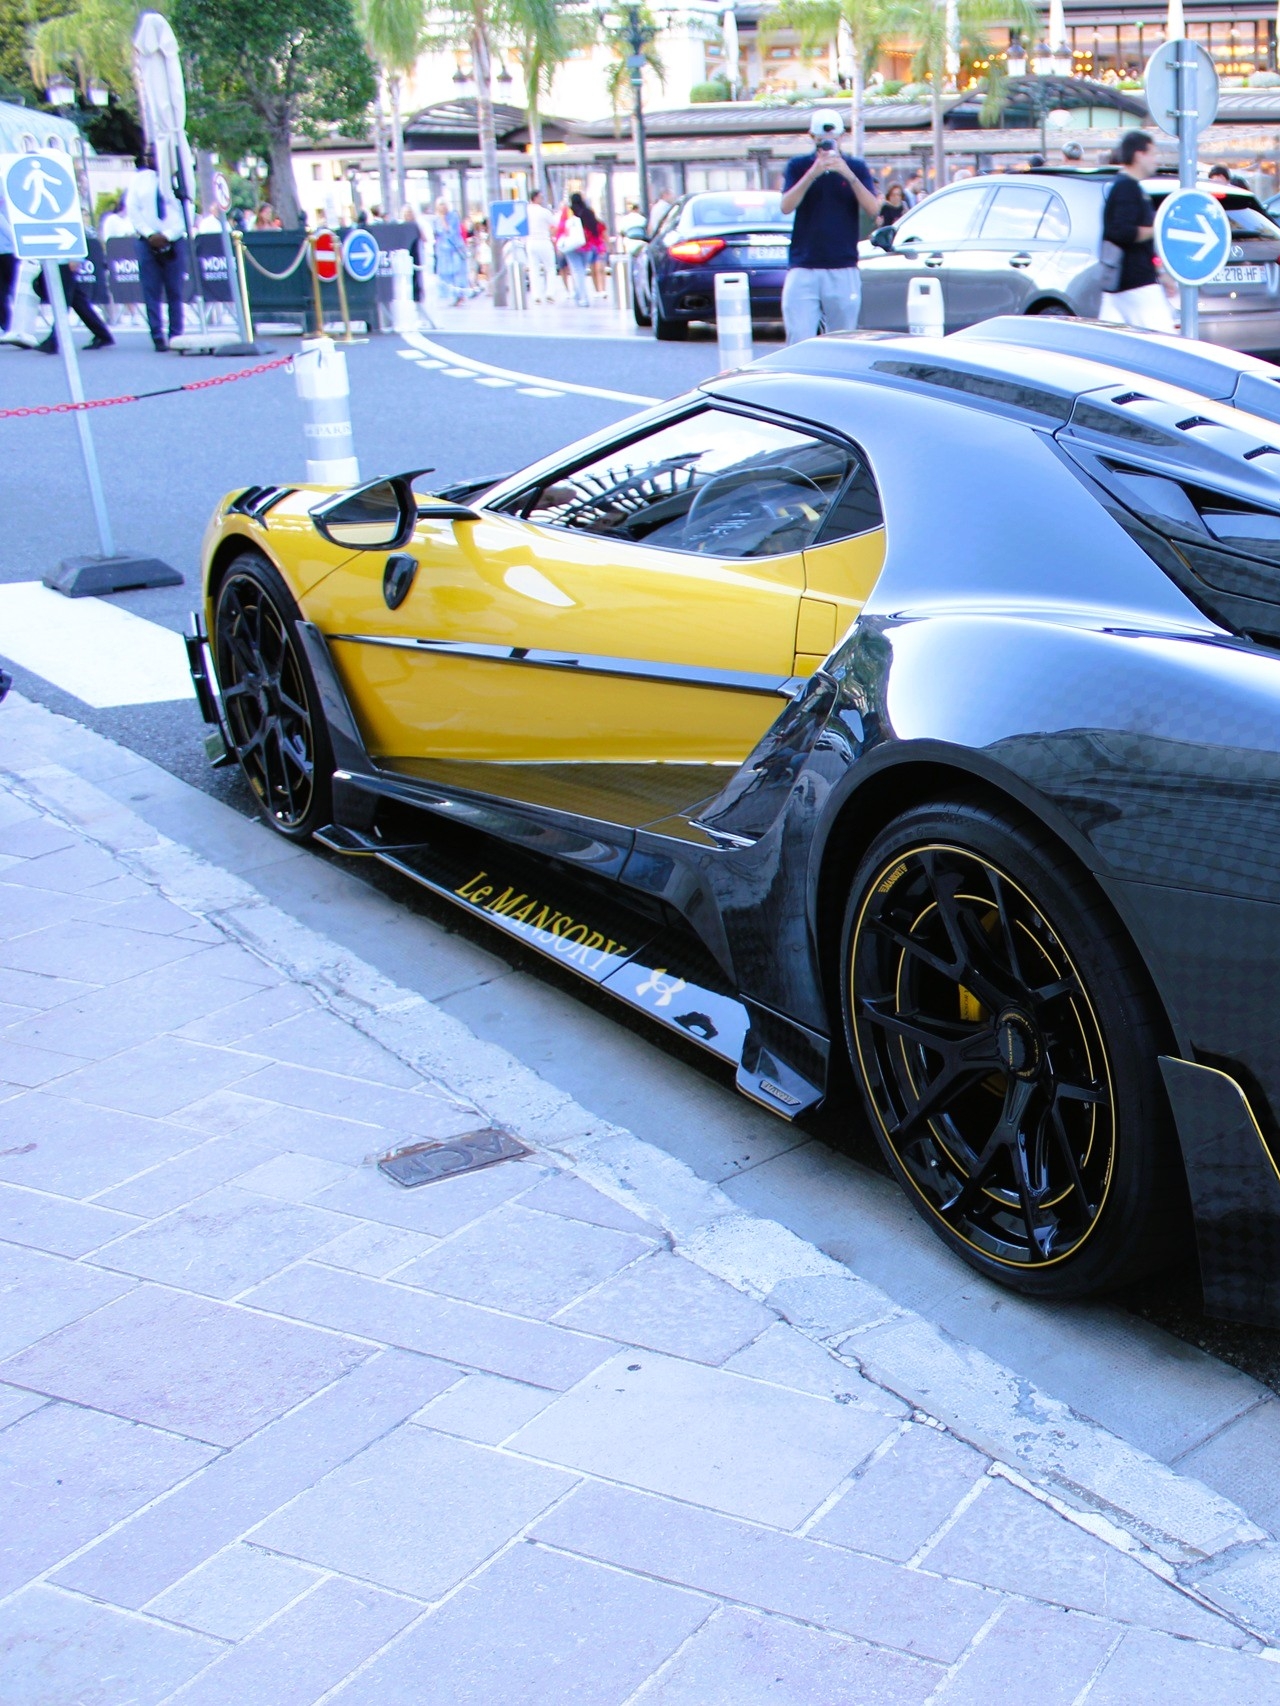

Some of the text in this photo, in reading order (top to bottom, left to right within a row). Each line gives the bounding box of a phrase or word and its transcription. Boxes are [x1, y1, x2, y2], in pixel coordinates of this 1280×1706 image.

[454, 871, 628, 972] Le MANSORY
[387, 1134, 503, 1180] ACM
